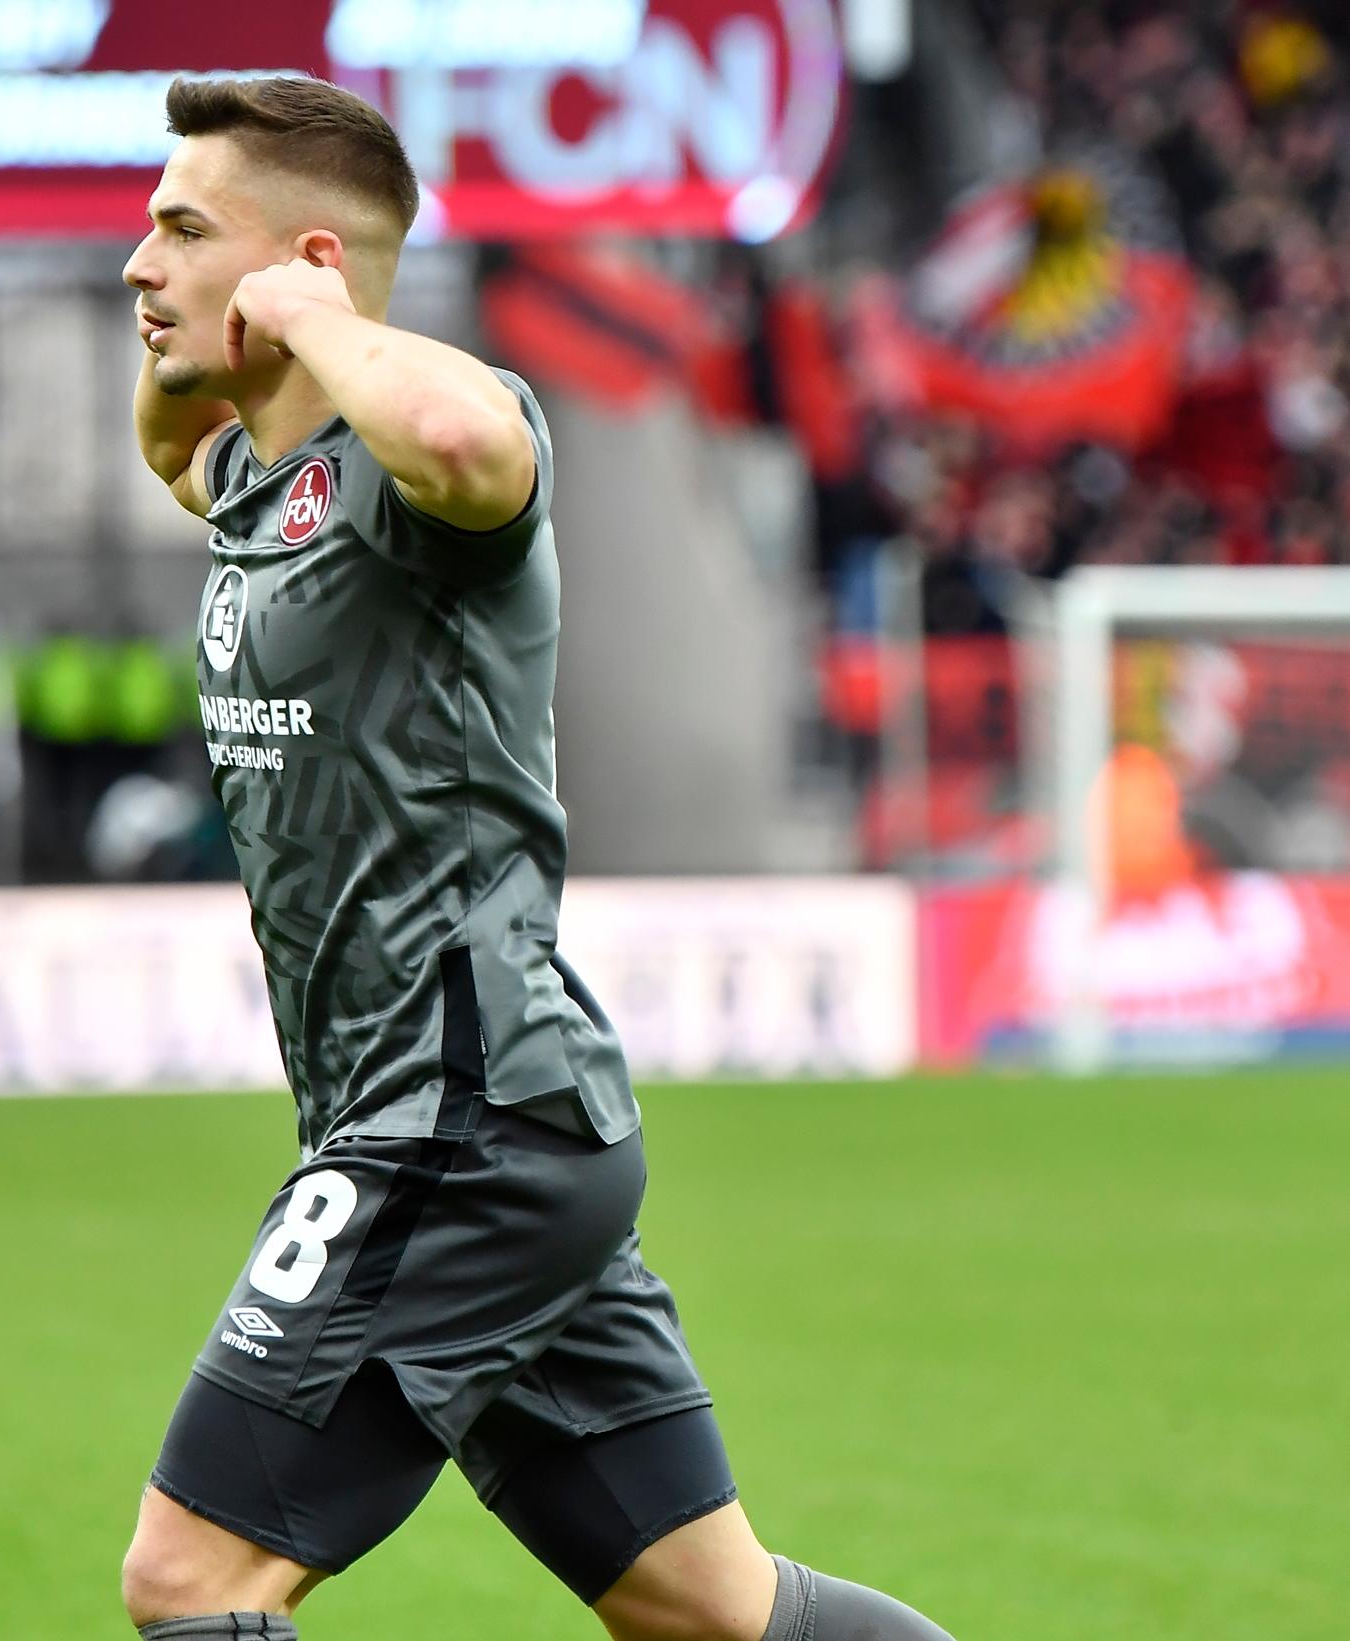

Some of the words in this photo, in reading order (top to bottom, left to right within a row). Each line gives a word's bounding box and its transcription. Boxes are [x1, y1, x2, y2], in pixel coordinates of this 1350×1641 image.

[282, 494, 324, 528] FCN
[249, 1169, 358, 1304] 8
[220, 1330, 268, 1359] umbro
